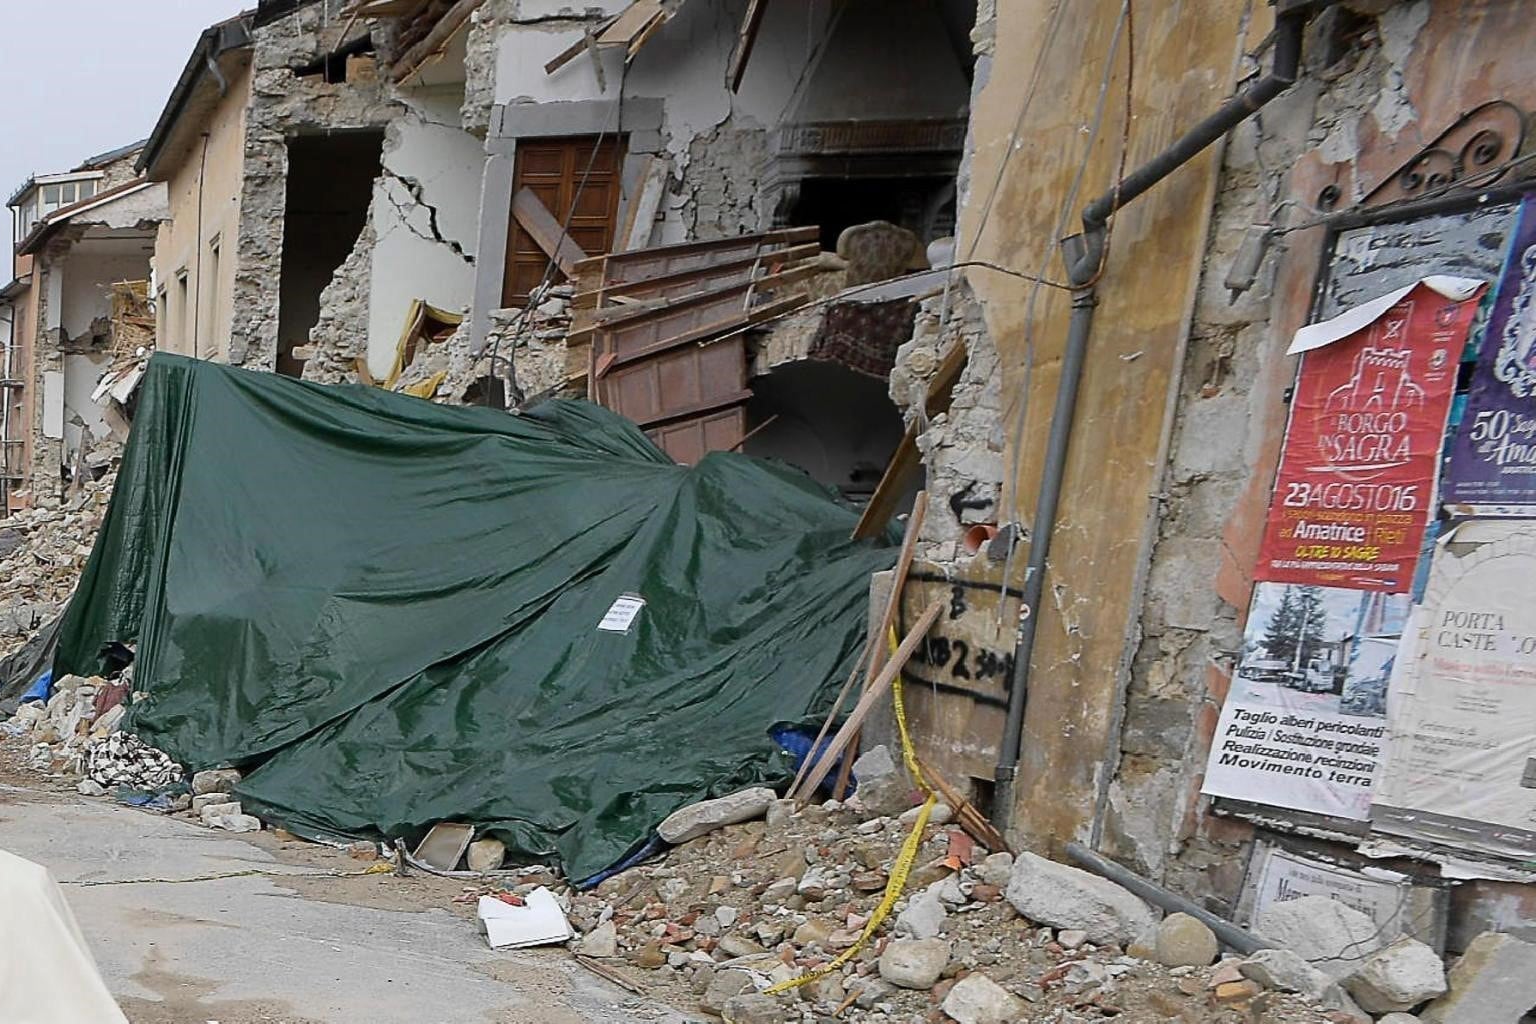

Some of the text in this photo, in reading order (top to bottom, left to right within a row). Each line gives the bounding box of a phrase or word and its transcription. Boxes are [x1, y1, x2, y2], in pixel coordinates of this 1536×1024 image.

[1338, 412, 1407, 434] BORGO
[1327, 434, 1412, 462] SAGRA
[1293, 520, 1365, 542] Amatrice
[1295, 545, 1330, 558] OLTRE
[1343, 546, 1382, 560] SAGRE
[1442, 611, 1504, 630] PORTA
[1233, 708, 1385, 738] Taglio alberi pericolanti
[1226, 724, 1266, 740] Pulizia
[1273, 729, 1334, 749] Sostituzione
[1335, 741, 1380, 757] grondaie
[1219, 753, 1372, 786] Movimento terra
[1222, 740, 1377, 772] Realizzazione recinzioni
